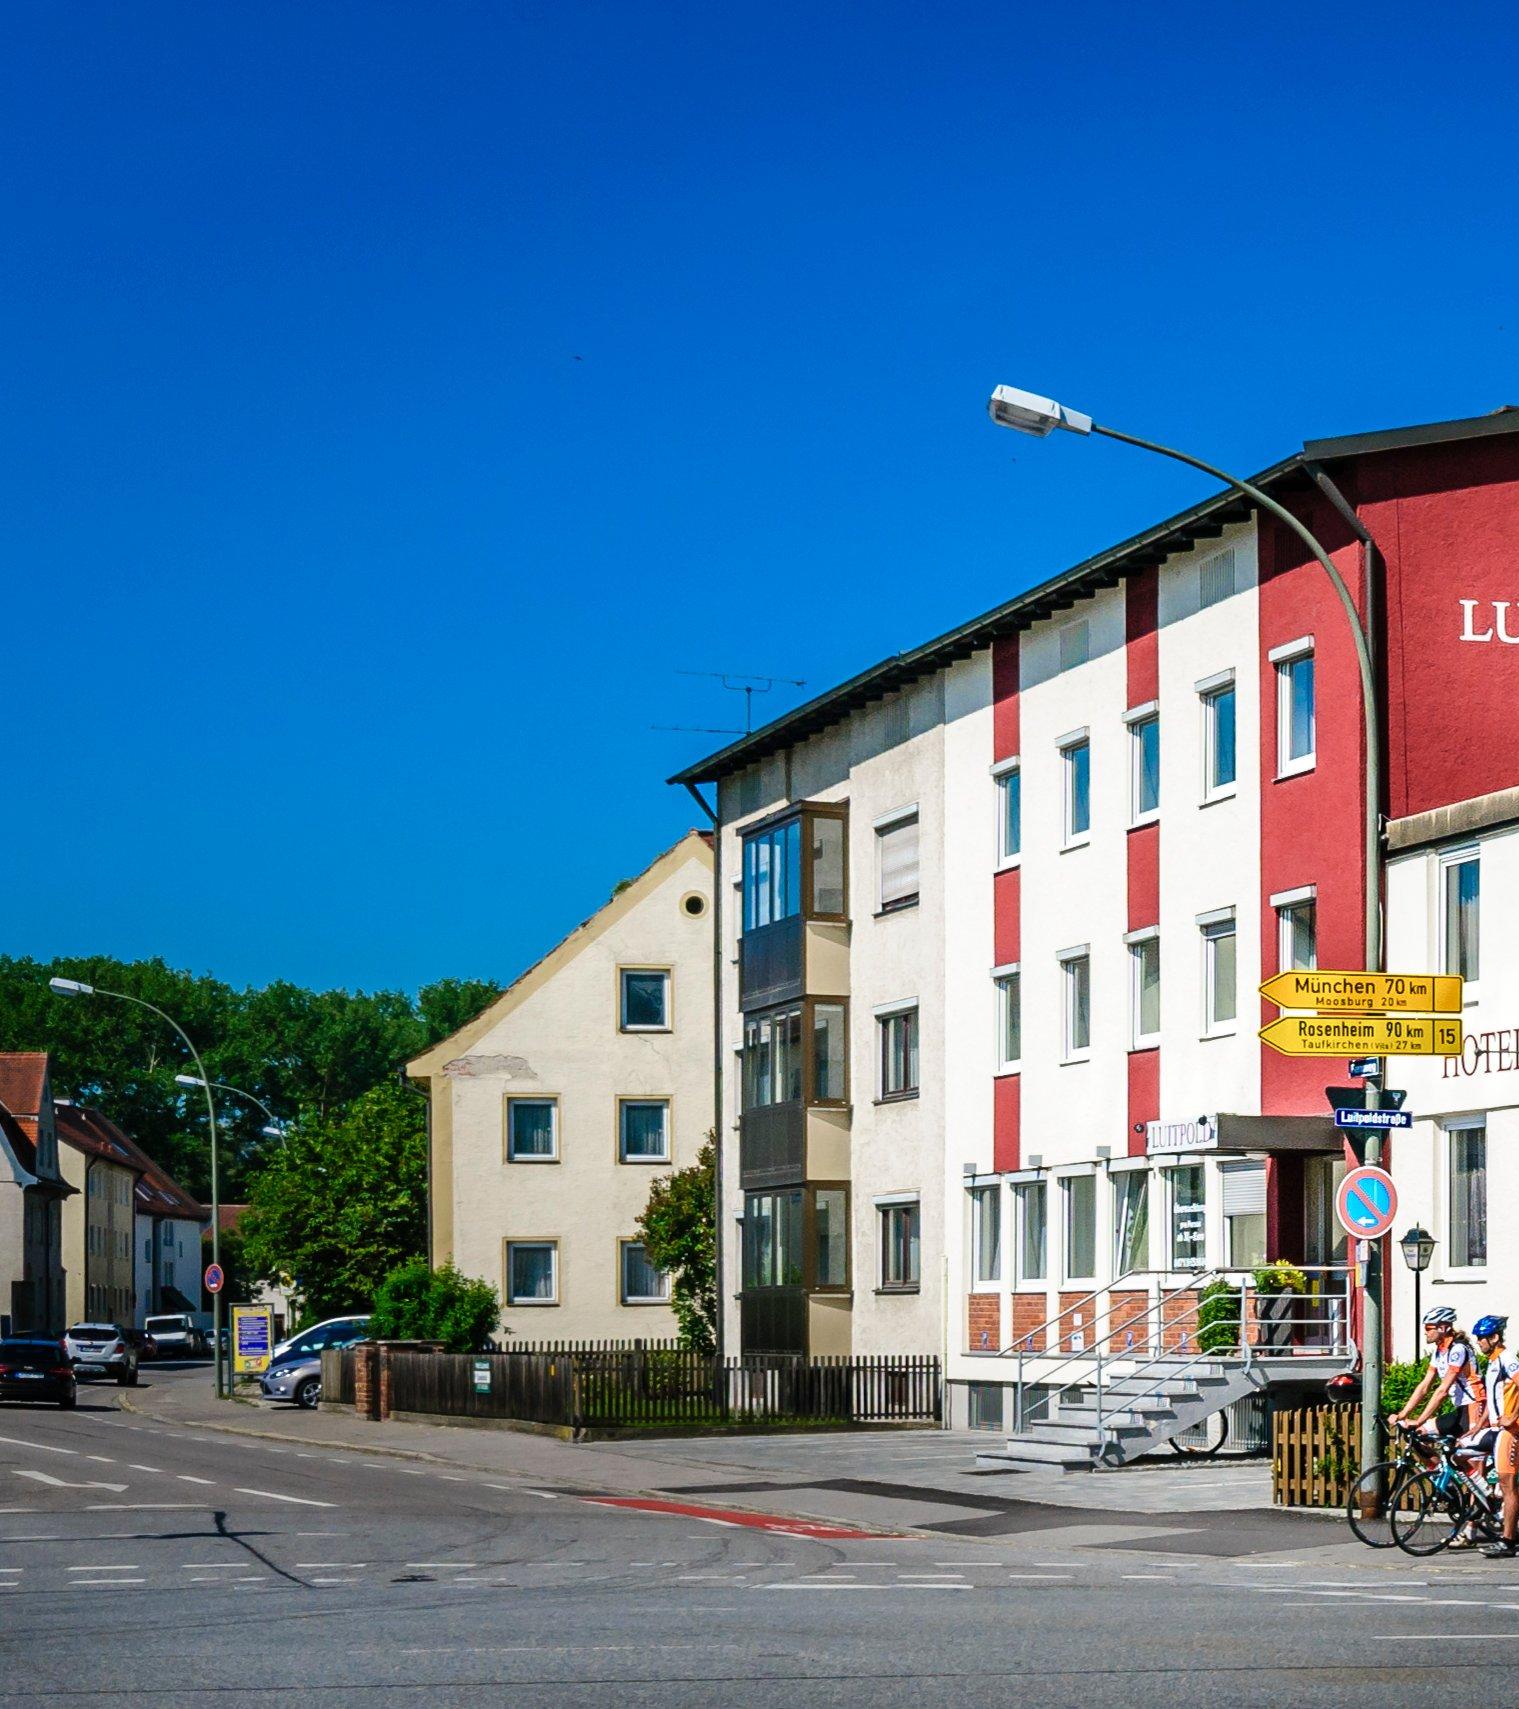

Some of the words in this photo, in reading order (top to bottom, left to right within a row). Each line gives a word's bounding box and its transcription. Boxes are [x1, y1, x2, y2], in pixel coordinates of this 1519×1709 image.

[1295, 977, 1376, 995] München
[1384, 978, 1405, 995] 70
[1409, 981, 1427, 995] km
[1315, 996, 1374, 1008] Moosburg
[1381, 997, 1394, 1007] 20
[1396, 999, 1407, 1007] km
[1298, 1020, 1375, 1038] Rosenheim
[1385, 1021, 1402, 1038] 90
[1406, 1024, 1424, 1038] km
[1438, 1028, 1456, 1045] 15
[1302, 1039, 1368, 1050] Taufkirchen
[1395, 1041, 1409, 1050] 27
[1410, 1041, 1422, 1050] km
[1340, 1110, 1407, 1126] Luitpoldstraße
[1152, 1120, 1212, 1149] LUITPOLD
